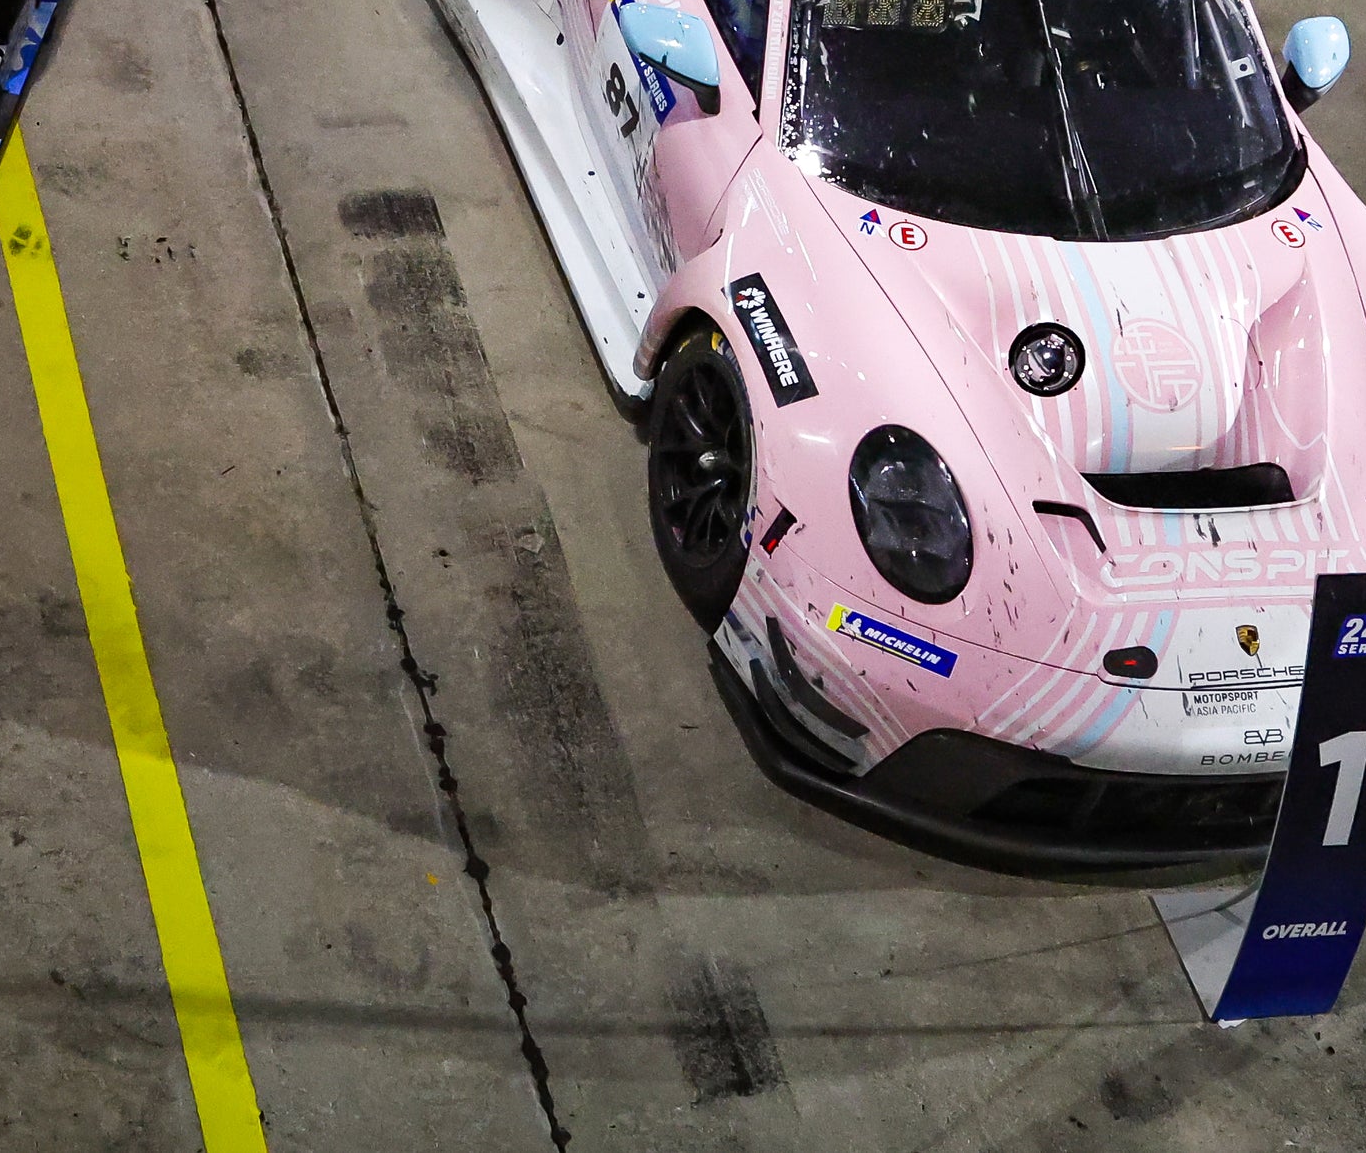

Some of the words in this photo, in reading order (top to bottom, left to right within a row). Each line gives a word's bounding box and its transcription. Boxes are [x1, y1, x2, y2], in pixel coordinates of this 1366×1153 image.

[605, 61, 640, 139] 87
[644, 67, 668, 113] SERIES
[900, 226, 916, 246] E
[749, 306, 800, 388] WINHERE
[863, 626, 942, 666] MICHELIN
[1188, 665, 1305, 684] PORSCHE
[1196, 705, 1219, 716] ASIA
[1220, 703, 1257, 715] PACIFIC
[1200, 750, 1292, 766] BOMBE
[1262, 920, 1348, 941] OVERALL
